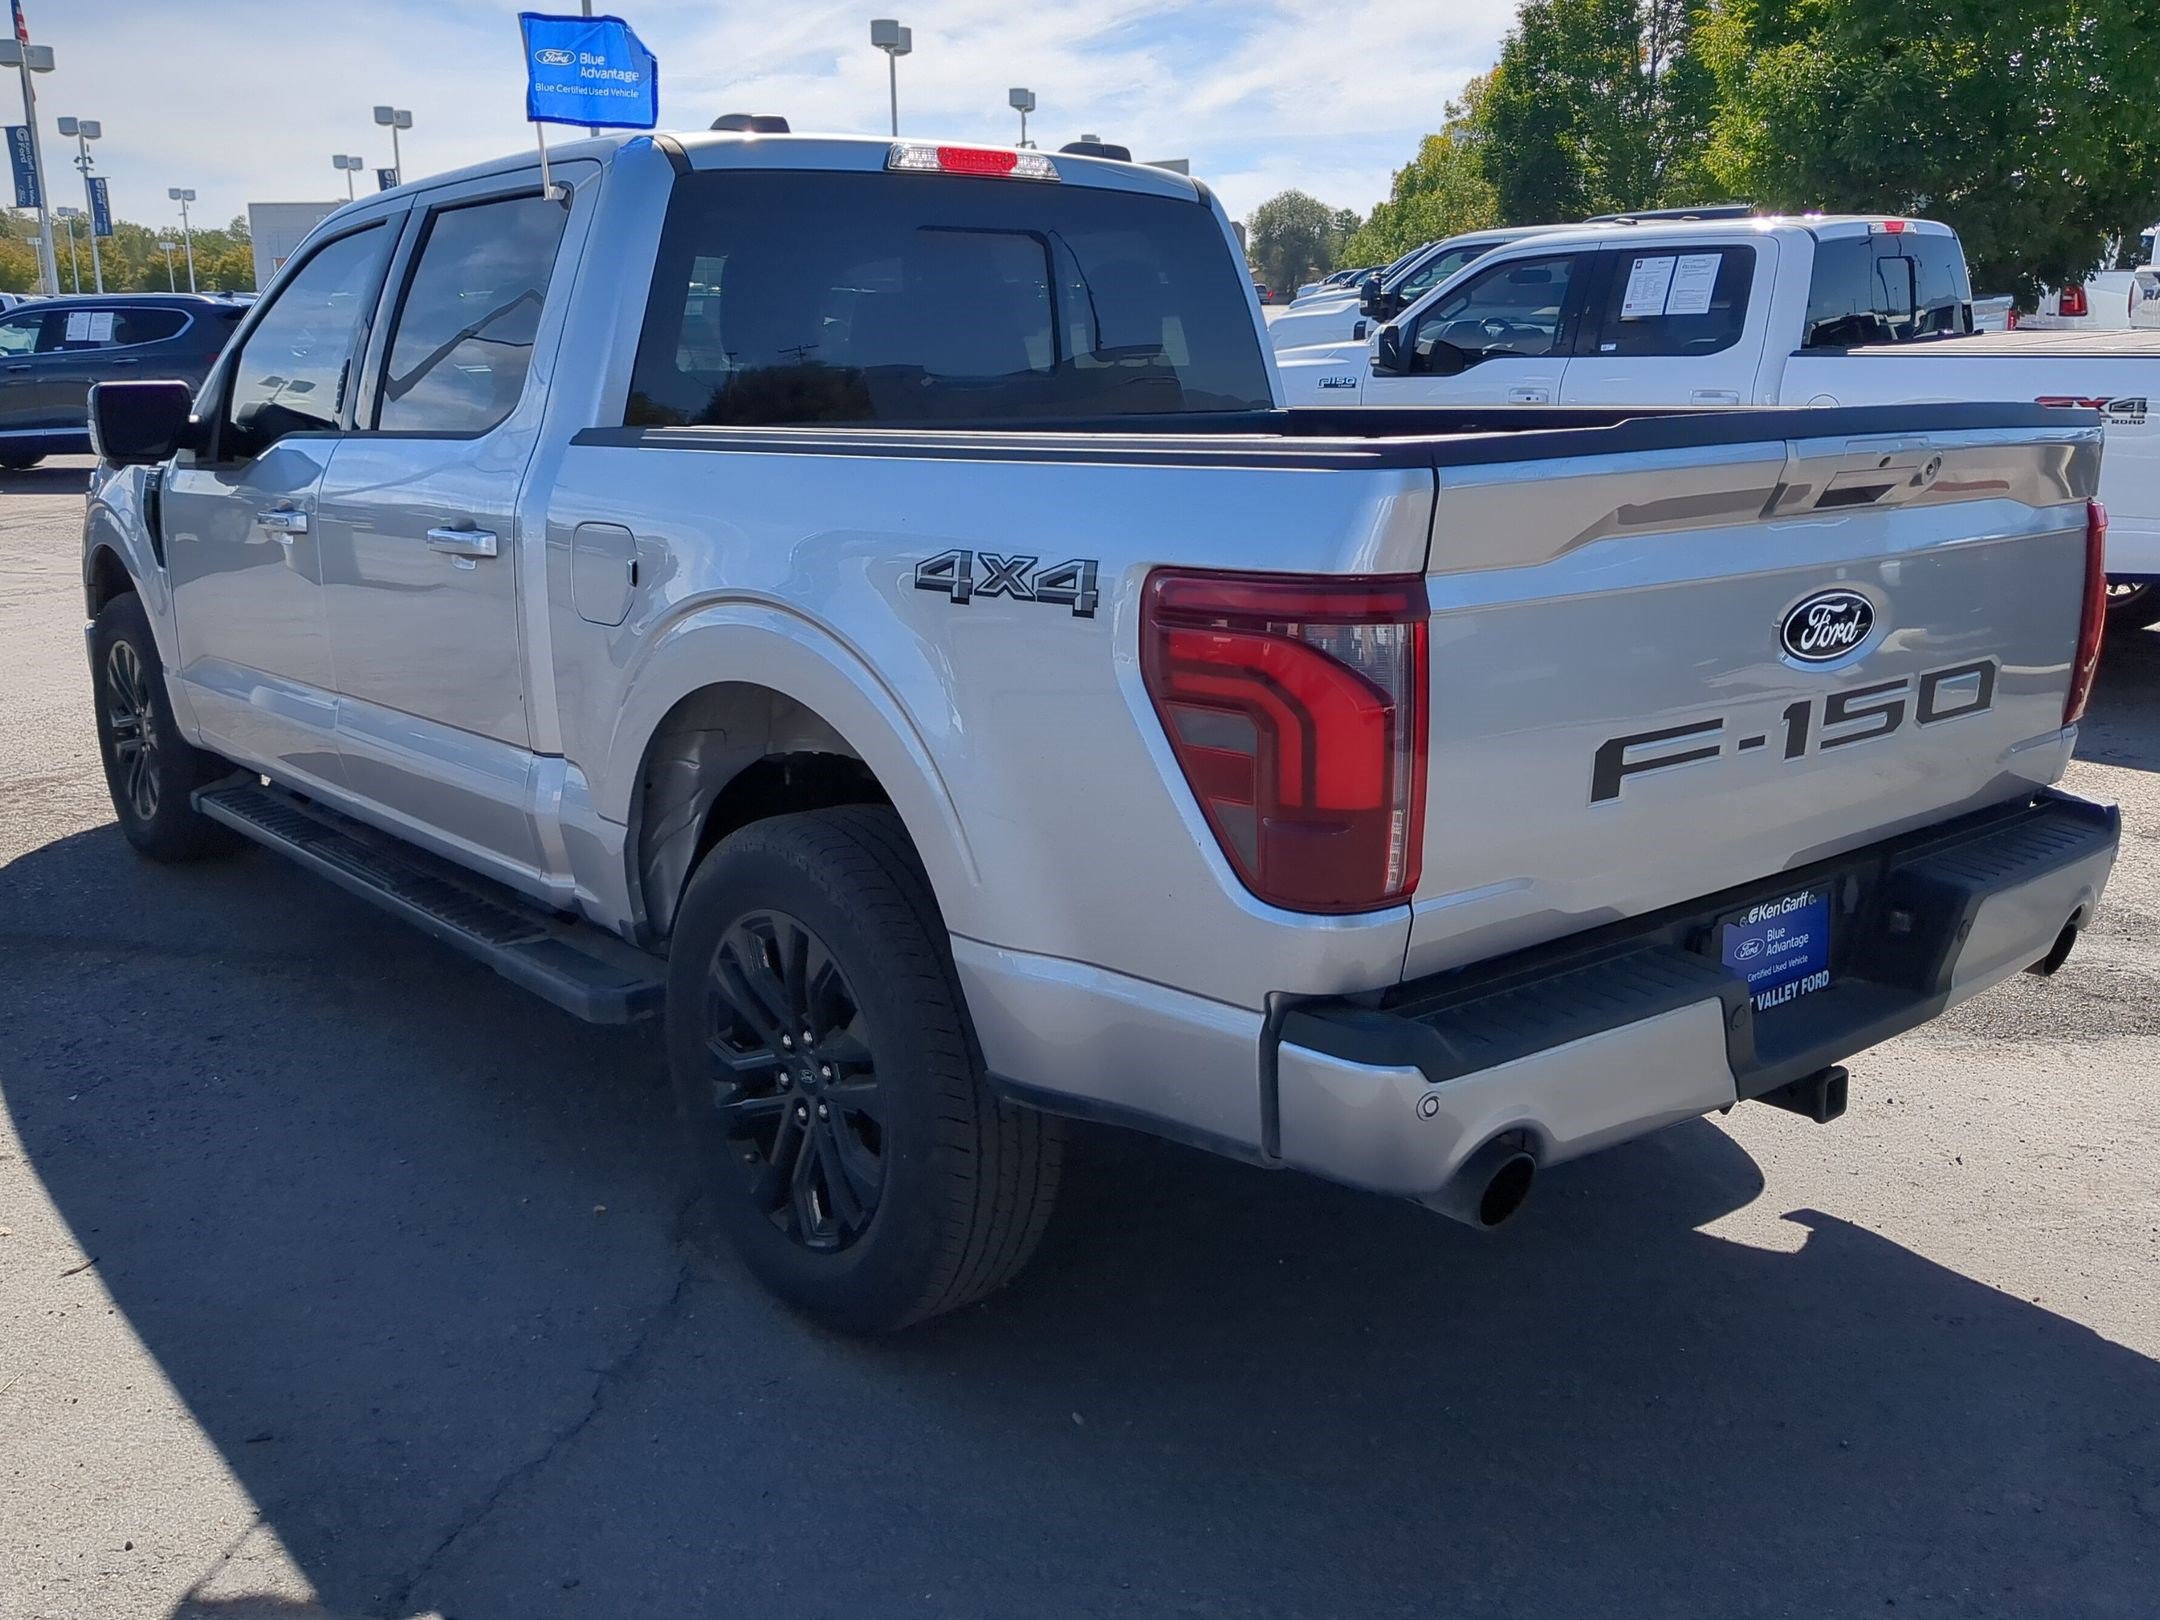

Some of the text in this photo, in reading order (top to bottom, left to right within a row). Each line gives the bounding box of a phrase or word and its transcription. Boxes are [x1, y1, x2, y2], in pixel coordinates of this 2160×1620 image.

[542, 50, 569, 63] Ford
[579, 52, 605, 65] Blue
[579, 67, 640, 83] Advantage
[535, 83, 640, 98] Blue Certified Used Vehicle
[1800, 602, 1862, 650] Ford
[1587, 654, 2001, 809] F-150
[1758, 903, 1780, 922] Ken
[1781, 890, 1809, 914] Garff
[1739, 933, 1809, 958] Ford Advantage
[1767, 927, 1785, 941] Blue
[1747, 954, 1809, 983] Certified Used Vehicle
[1757, 970, 1830, 1011] VALLEY FORD
